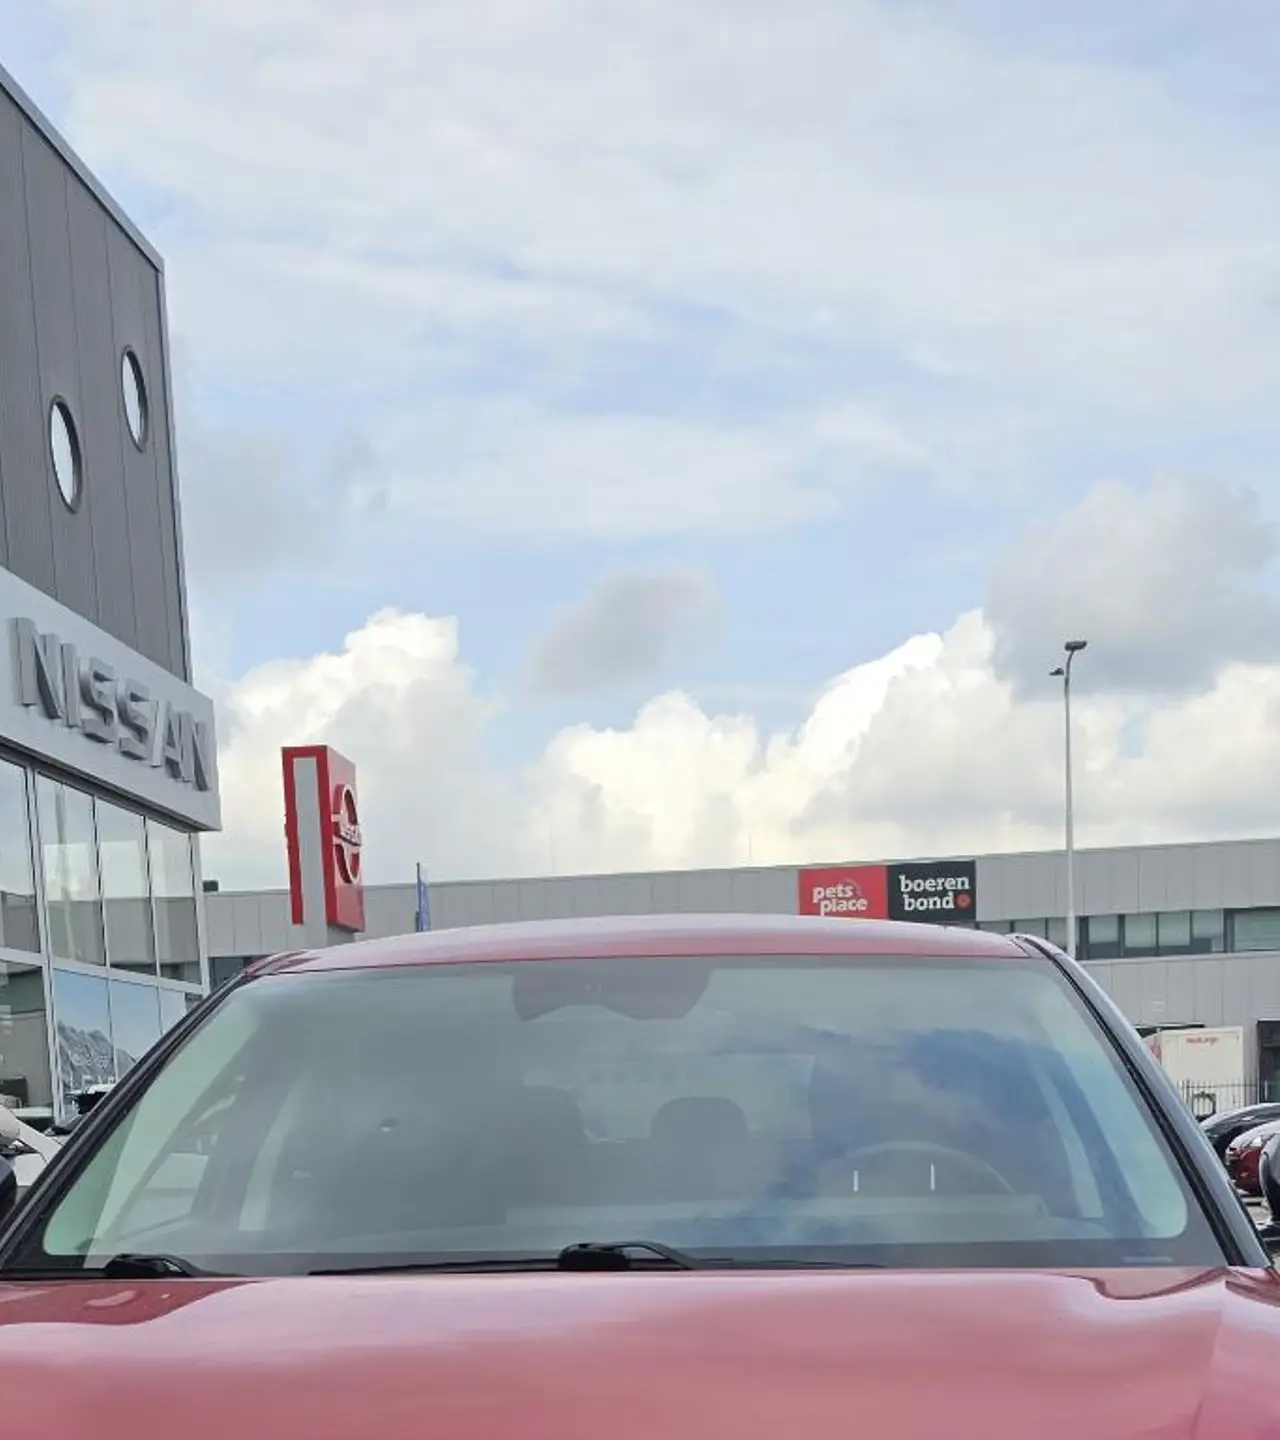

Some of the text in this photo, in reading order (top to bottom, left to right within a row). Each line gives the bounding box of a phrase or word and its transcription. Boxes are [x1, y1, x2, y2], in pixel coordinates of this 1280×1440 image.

[8, 616, 211, 792] NISSAN
[812, 882, 854, 903] pets
[899, 874, 971, 892] boeren
[820, 897, 869, 917] place
[903, 892, 955, 911] bond
